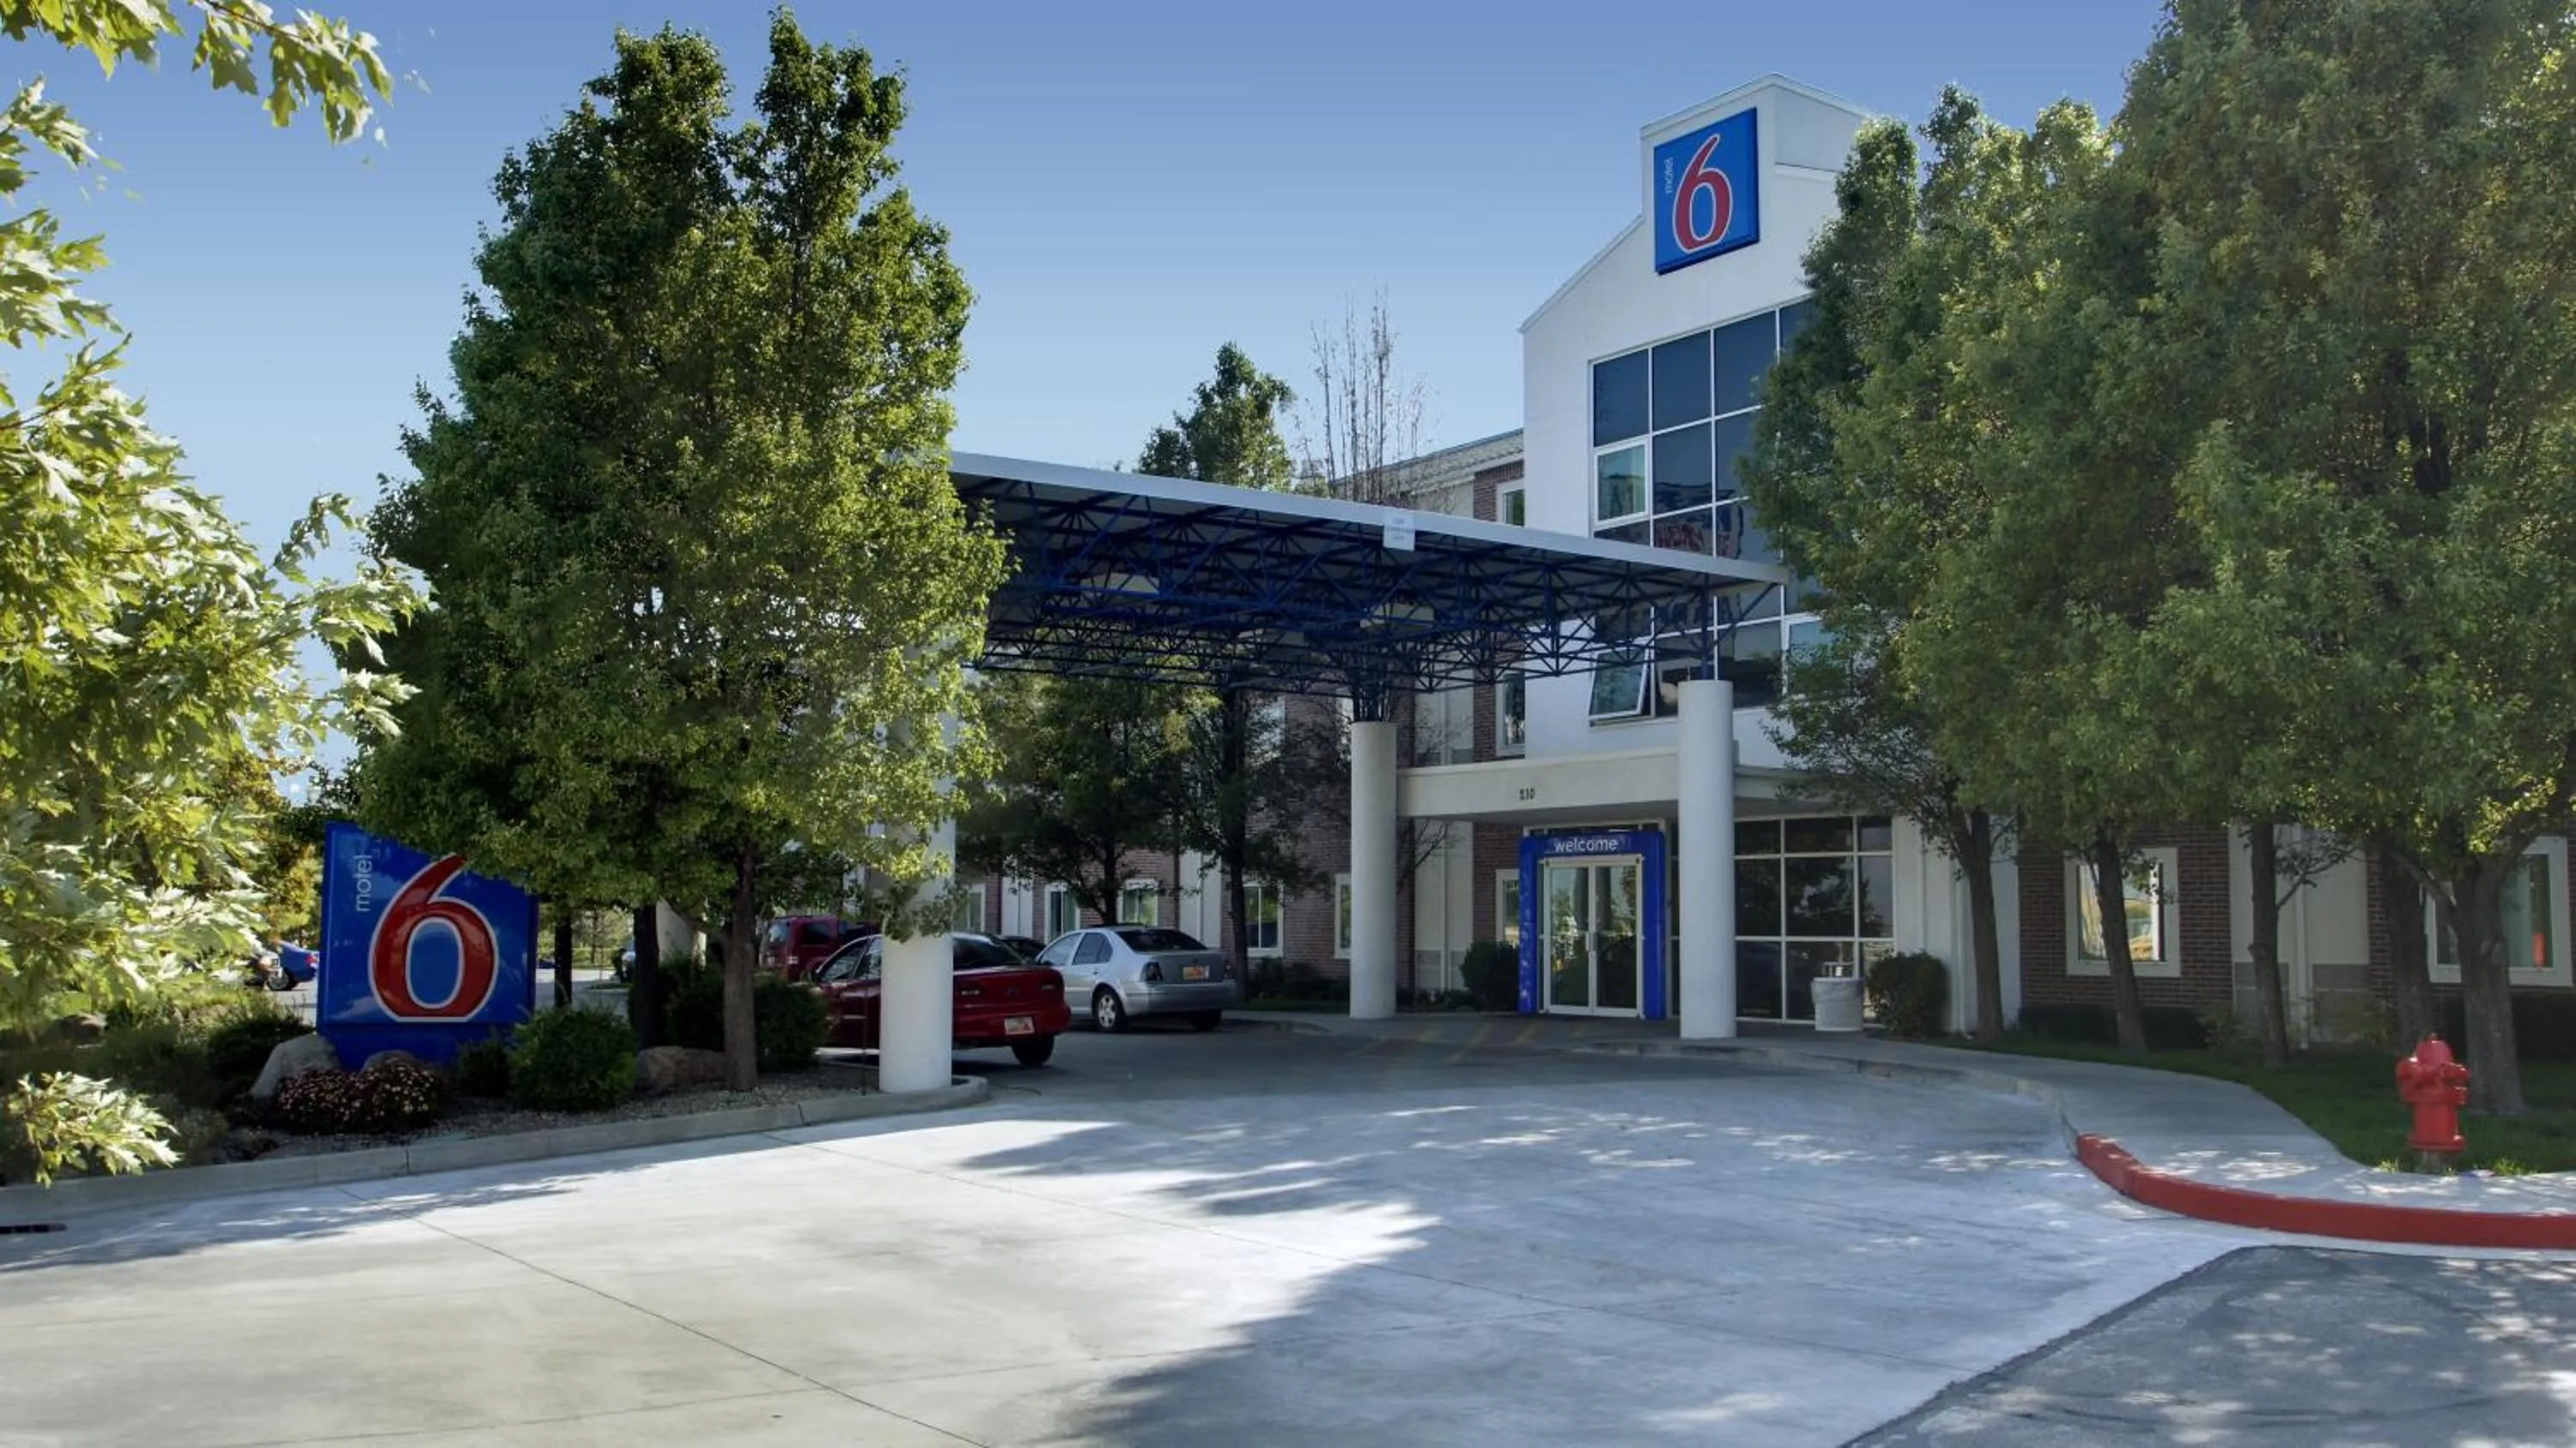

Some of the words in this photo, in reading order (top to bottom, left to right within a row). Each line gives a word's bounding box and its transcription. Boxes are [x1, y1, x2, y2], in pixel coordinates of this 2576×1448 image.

[1673, 133, 1734, 254] 6
[1553, 837, 1619, 853] welcome
[353, 855, 372, 912] motel
[368, 852, 500, 1022] 6
